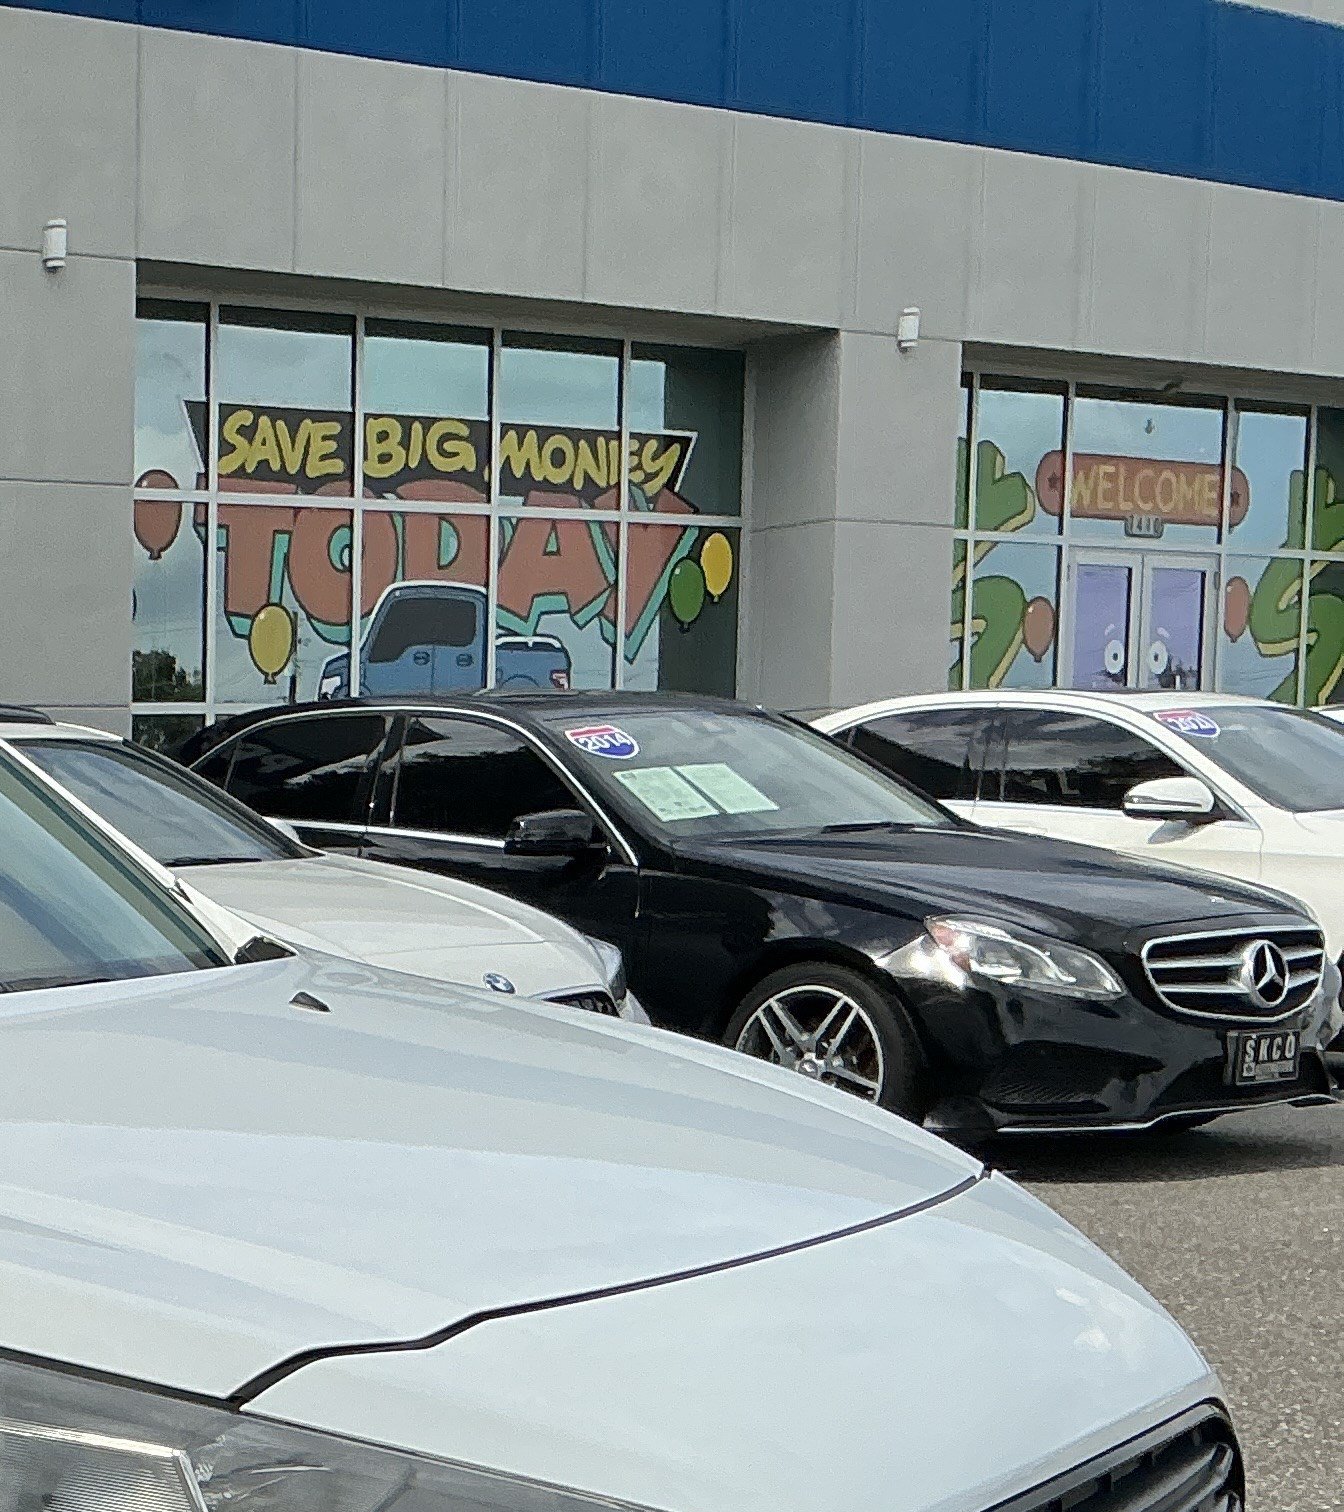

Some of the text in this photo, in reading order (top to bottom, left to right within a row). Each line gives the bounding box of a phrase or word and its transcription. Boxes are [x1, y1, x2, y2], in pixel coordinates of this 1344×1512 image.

[218, 408, 682, 495] SAVE BIG MONEY
[1070, 464, 1219, 517] WELCOME
[196, 476, 698, 640] TODAY
[580, 731, 632, 751] 2014
[1244, 1034, 1296, 1064] SKCO
